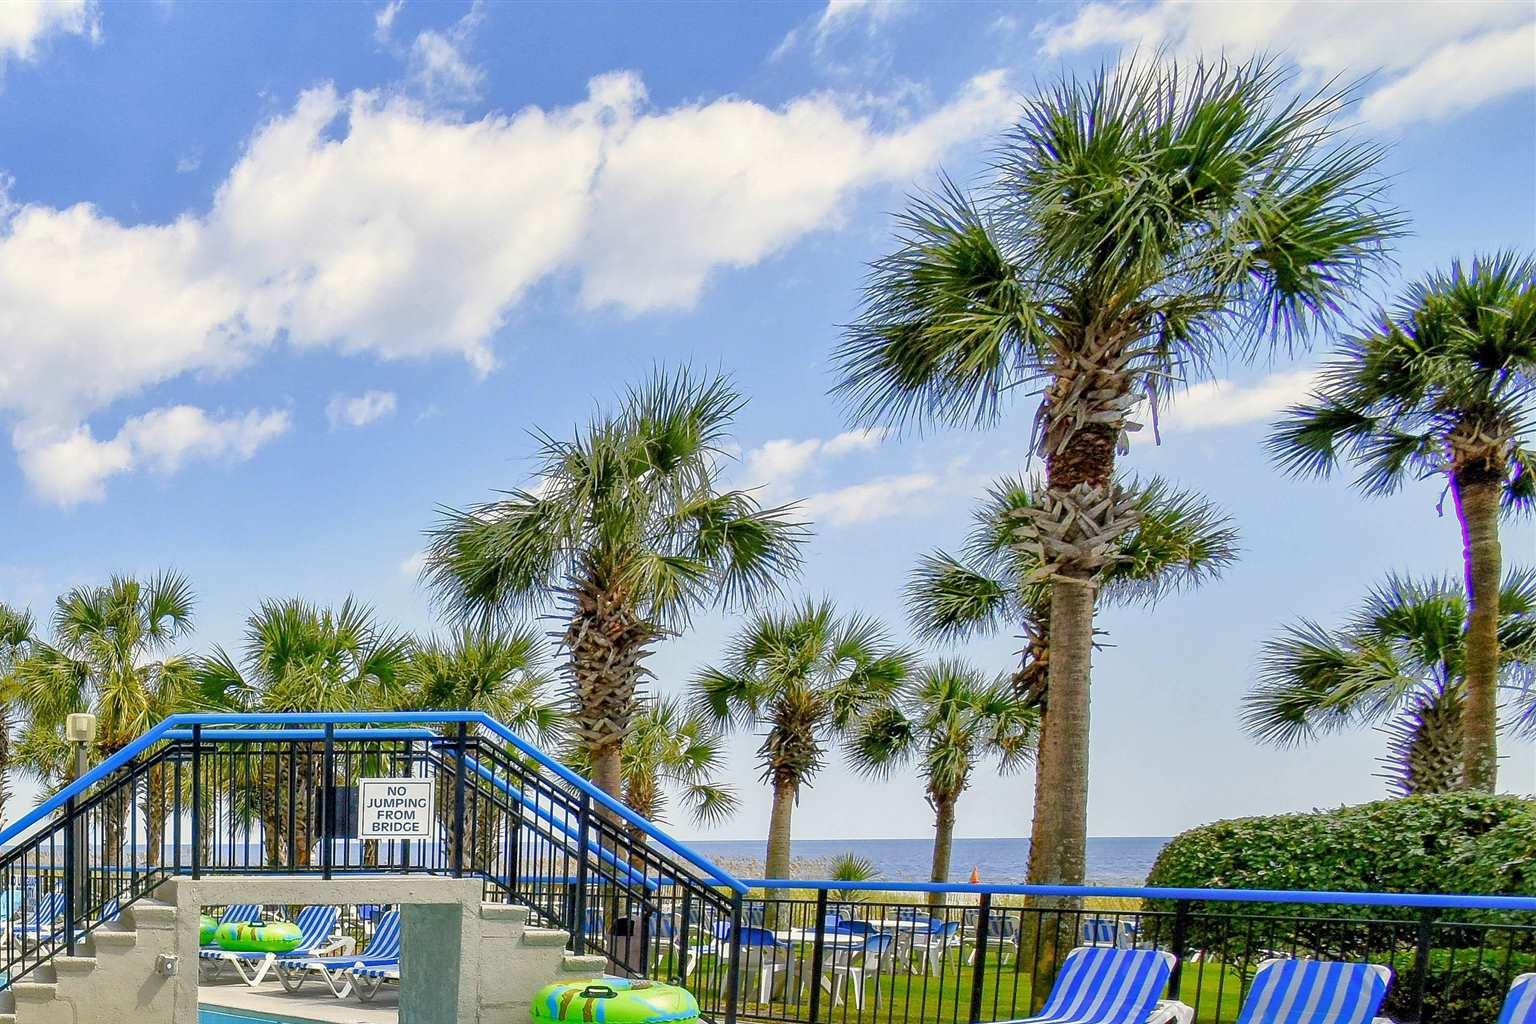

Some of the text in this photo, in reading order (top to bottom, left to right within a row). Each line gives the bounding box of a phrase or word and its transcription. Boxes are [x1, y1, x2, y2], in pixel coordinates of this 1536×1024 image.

[387, 786, 407, 796] NO
[367, 798, 427, 808] JUMPING
[377, 810, 415, 820] FROM
[372, 822, 420, 832] BRIDGE
